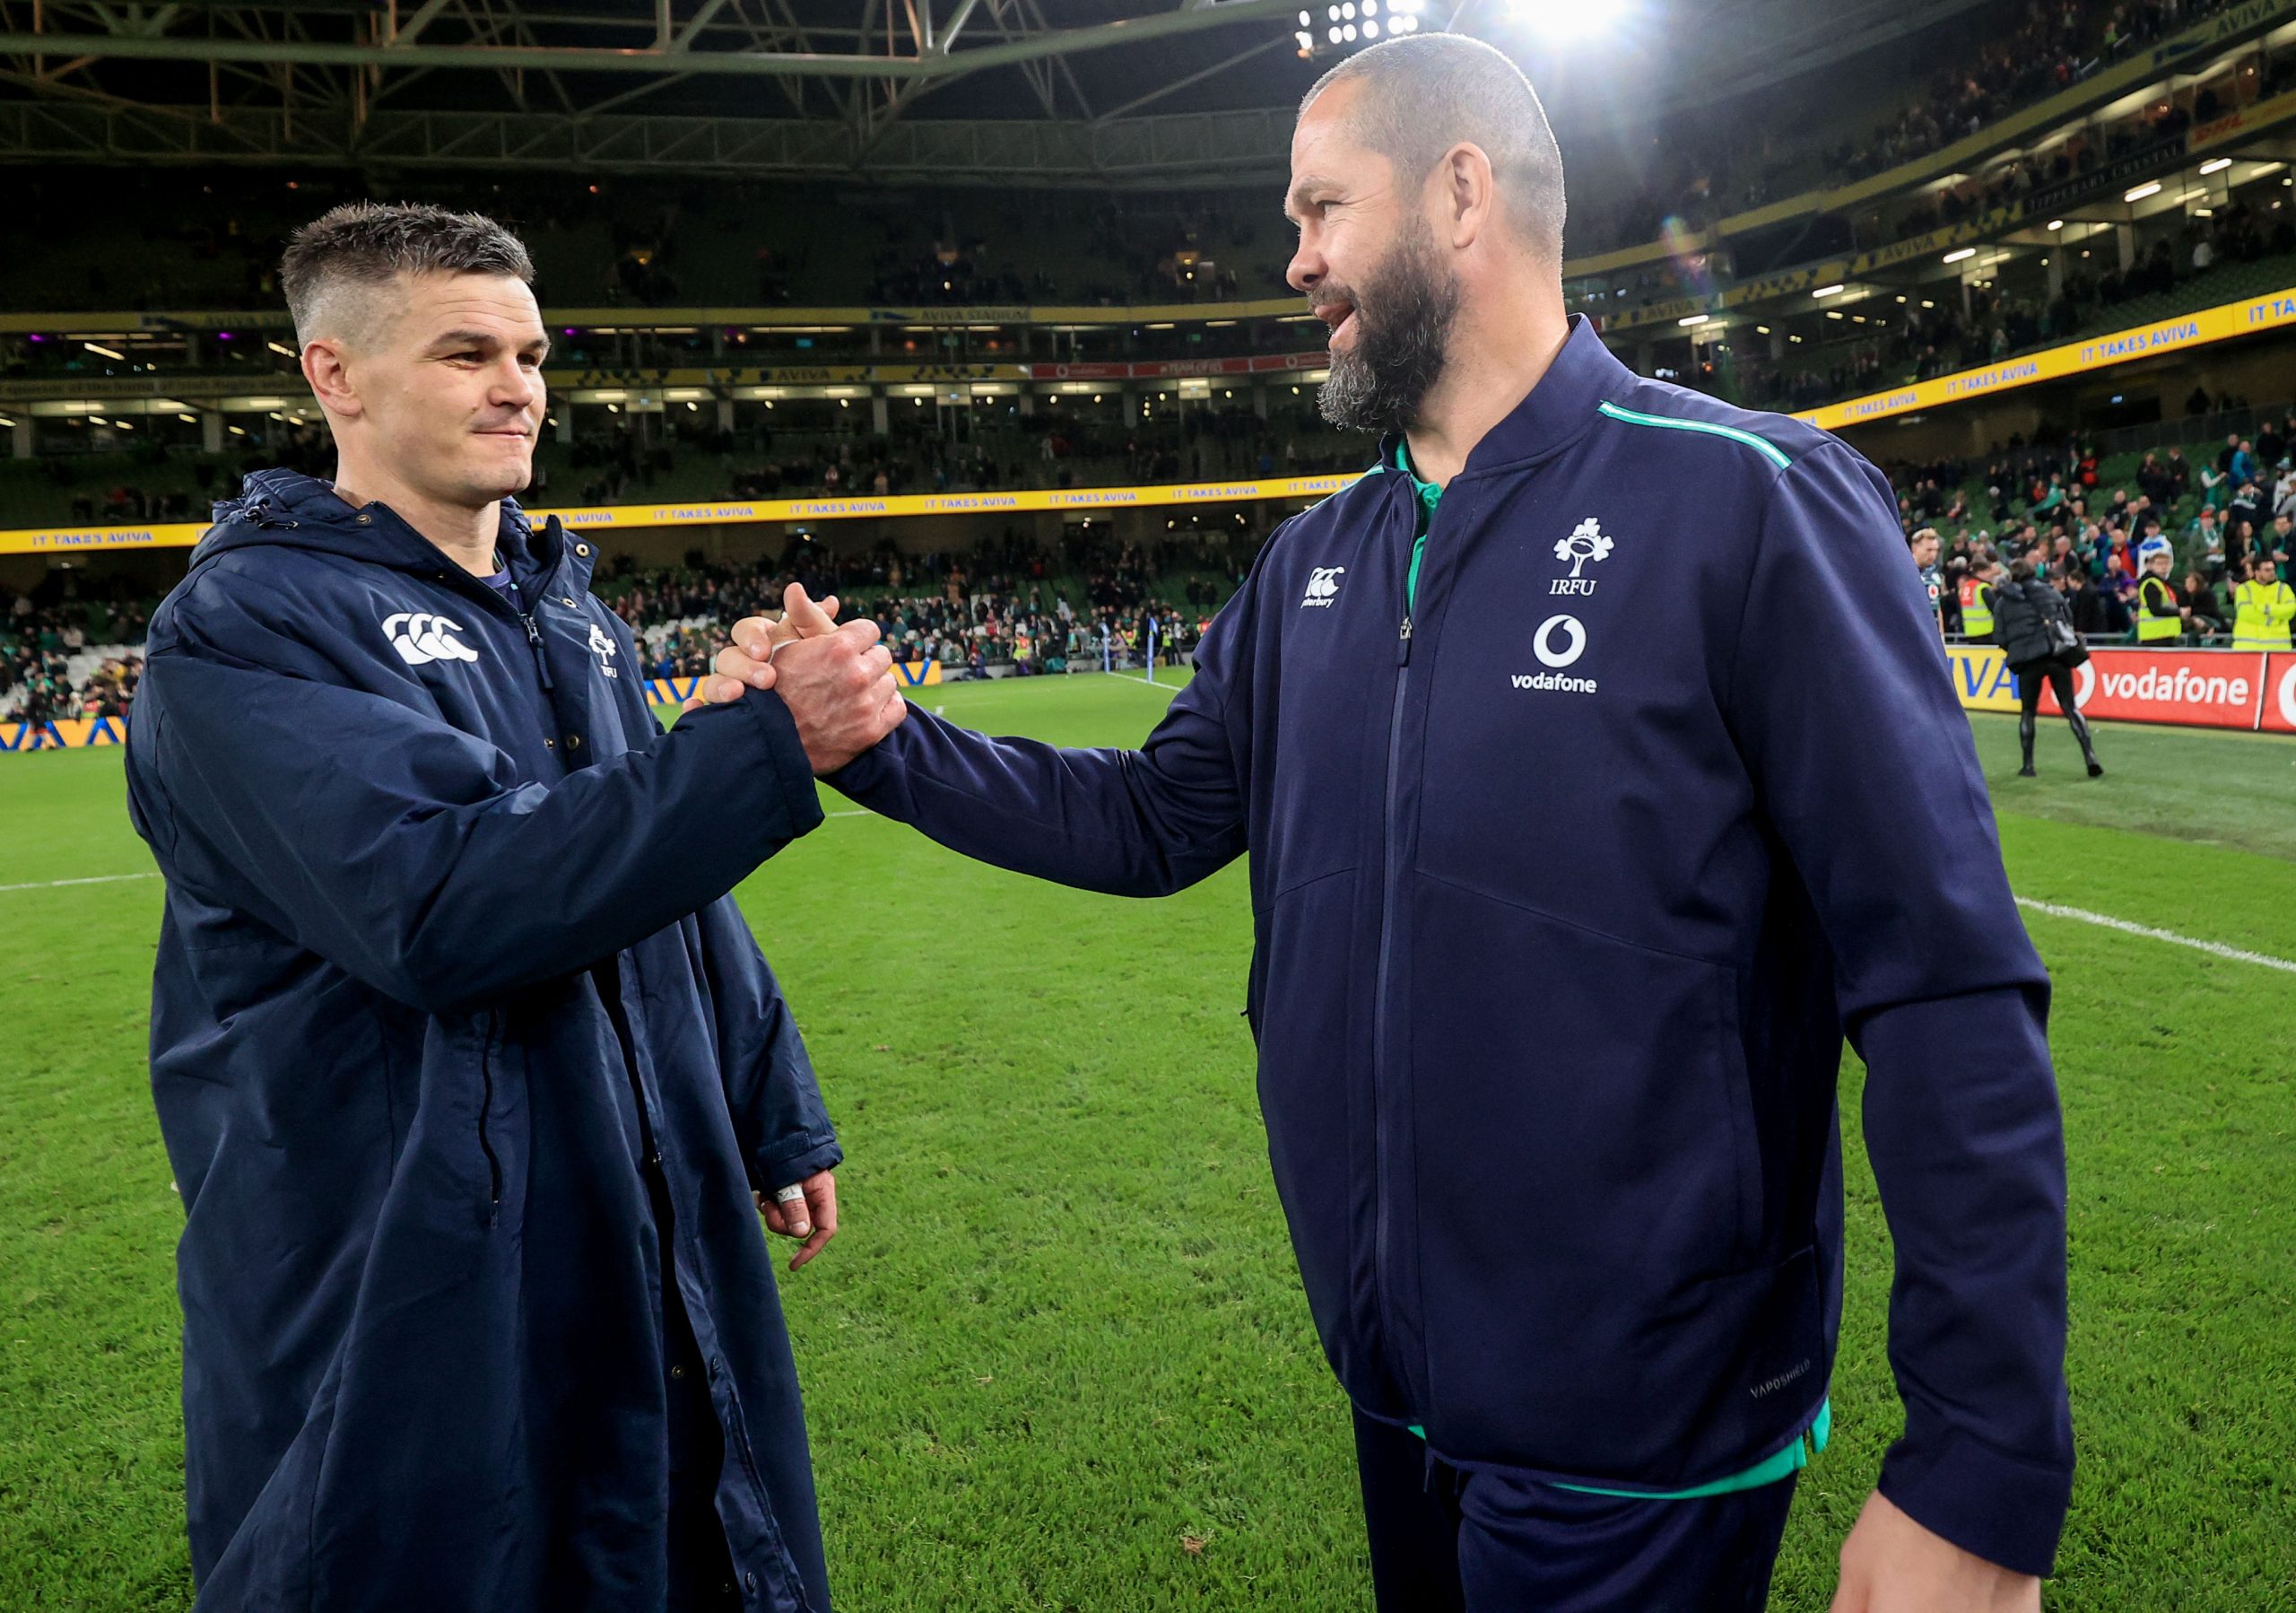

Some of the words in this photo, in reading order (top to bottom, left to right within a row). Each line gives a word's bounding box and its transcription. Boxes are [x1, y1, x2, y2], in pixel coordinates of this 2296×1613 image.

[921, 310, 963, 320] AVIVA
[967, 309, 1028, 321] STADIUM
[2249, 305, 2266, 323] IT
[2082, 347, 2093, 363] IT
[2099, 334, 2145, 358] TAKES
[2151, 322, 2198, 345] AVIVA
[778, 369, 829, 381] AVIVA
[1946, 381, 1957, 395] IT
[1961, 371, 1998, 390] TAKES
[2001, 362, 2037, 381] AVIVA
[1844, 407, 1854, 419] IT
[1856, 399, 1884, 416] TAKES
[1887, 391, 1917, 408] AVIVA
[1172, 490, 1183, 499] IT
[1187, 487, 1222, 498] TAKES
[1224, 485, 1257, 496] AVIVA
[1288, 483, 1299, 493] IT
[1302, 480, 1337, 491] TAKES
[925, 500, 936, 510] IT
[941, 498, 978, 508] TAKES
[981, 497, 1015, 507] AVIVA
[1048, 494, 1060, 504] IT
[1064, 493, 1100, 503] TAKES
[1103, 492, 1136, 501] AVIVA
[654, 510, 666, 519] IT
[671, 508, 712, 518] TAKES
[716, 507, 753, 517] AVIVA
[789, 504, 802, 514] IT
[806, 503, 846, 513] TAKES
[849, 501, 885, 511] AVIVA
[574, 512, 613, 523] AVIVA
[55, 533, 102, 545] TAKES
[108, 531, 152, 543] AVIVA
[1549, 579, 1596, 596] IRFU
[1510, 672, 1597, 693] vodafone
[2101, 667, 2248, 705] vodafone
[1750, 1358, 1810, 1399] VAPOSHIELD
